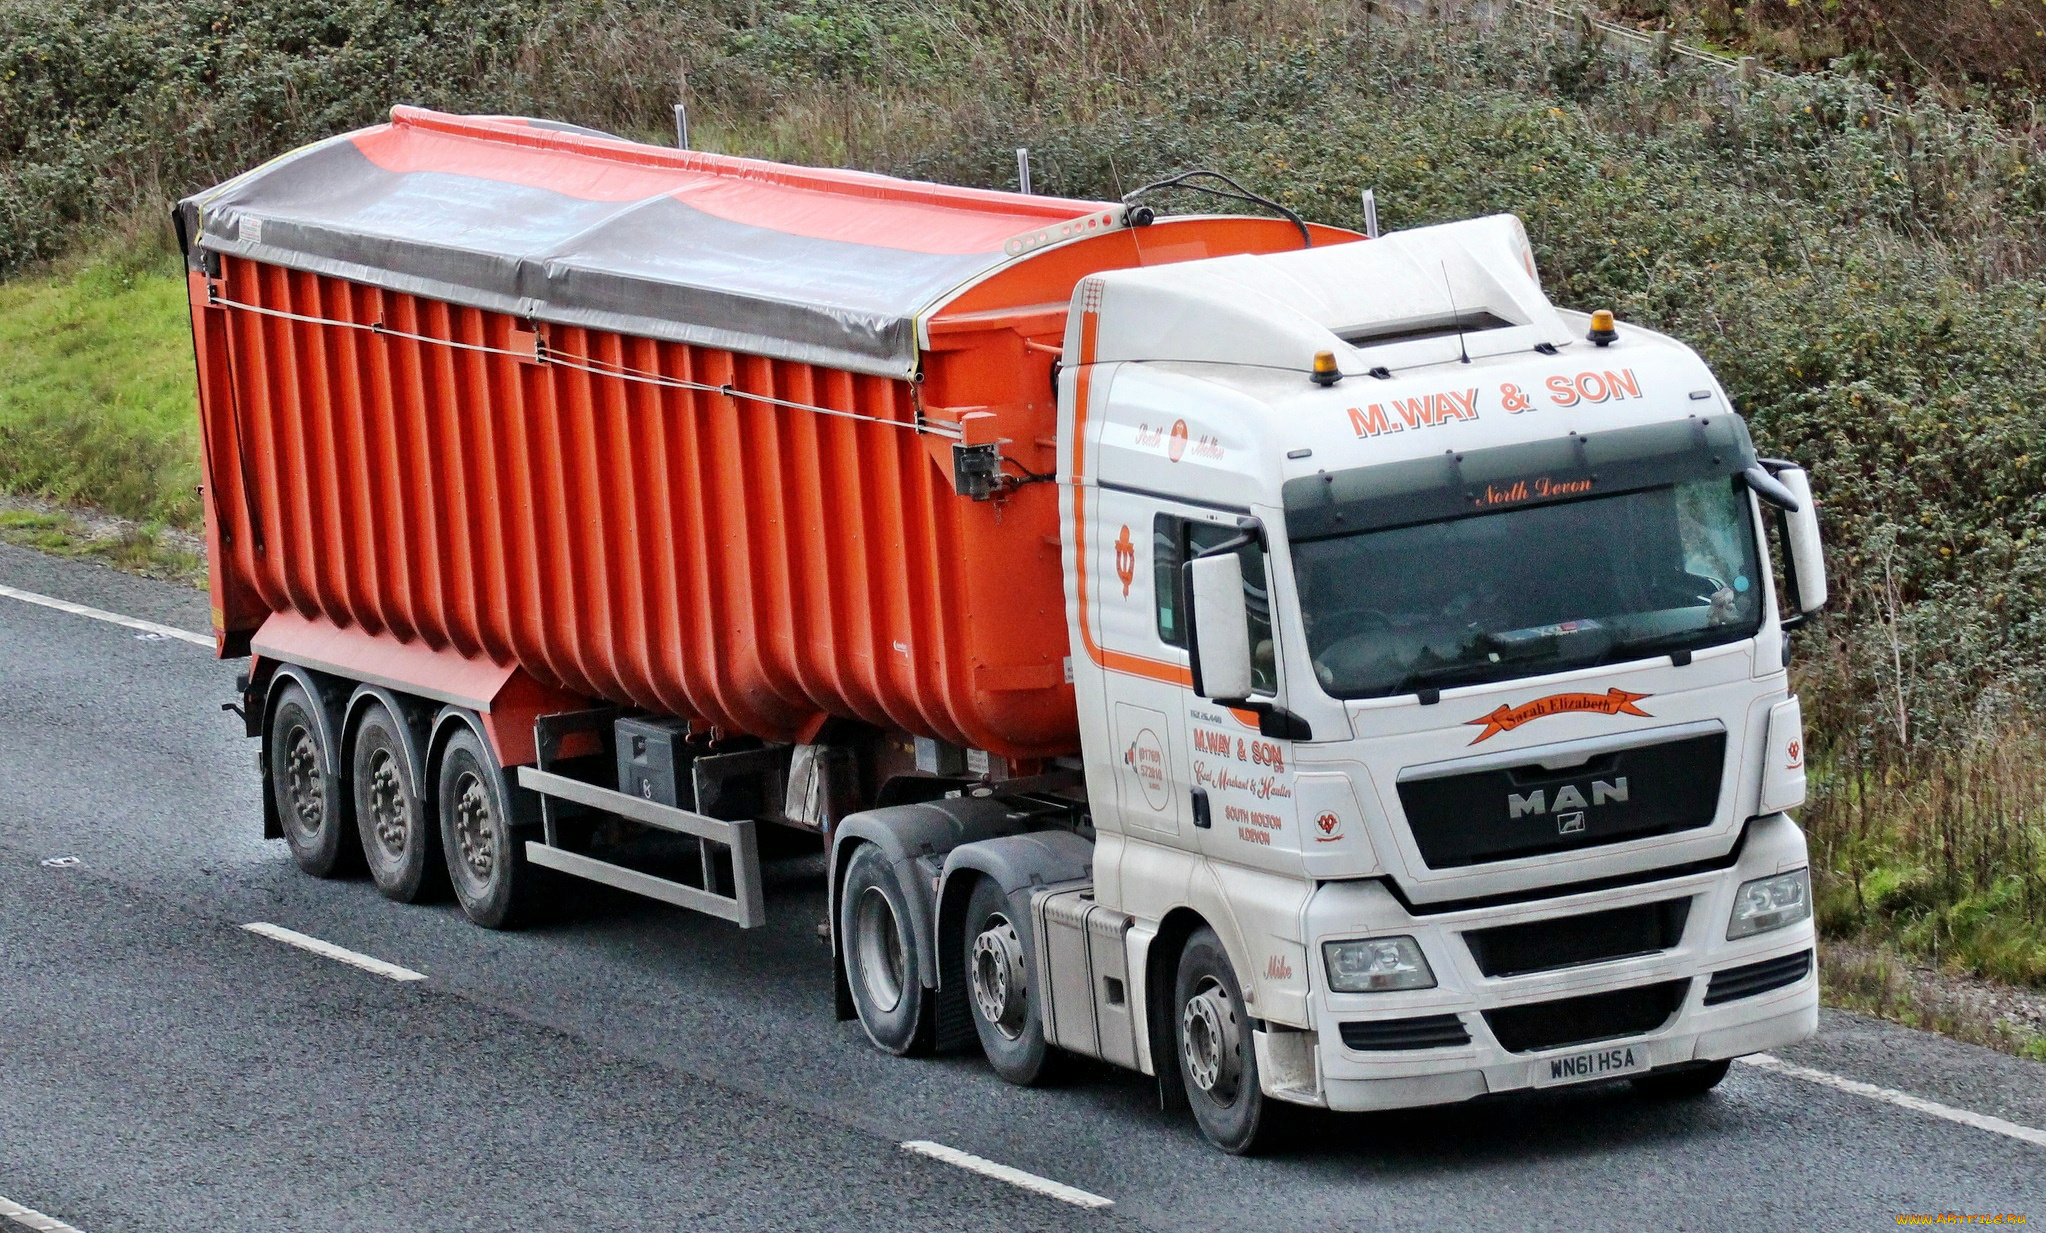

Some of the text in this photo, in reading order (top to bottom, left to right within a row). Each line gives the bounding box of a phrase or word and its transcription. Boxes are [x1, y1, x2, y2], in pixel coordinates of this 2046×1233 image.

[1347, 368, 1643, 440] M.WAY & SON
[1475, 477, 1592, 507] North Devon
[1506, 696, 1611, 726] Sarah Elizabeth
[1193, 727, 1285, 767] M.WAY & SON
[1507, 776, 1630, 819] MAN
[1225, 804, 1282, 831] SOUTH MOLTON
[1263, 955, 1293, 980] Mike
[1550, 1047, 1635, 1079] WN61 HSA
